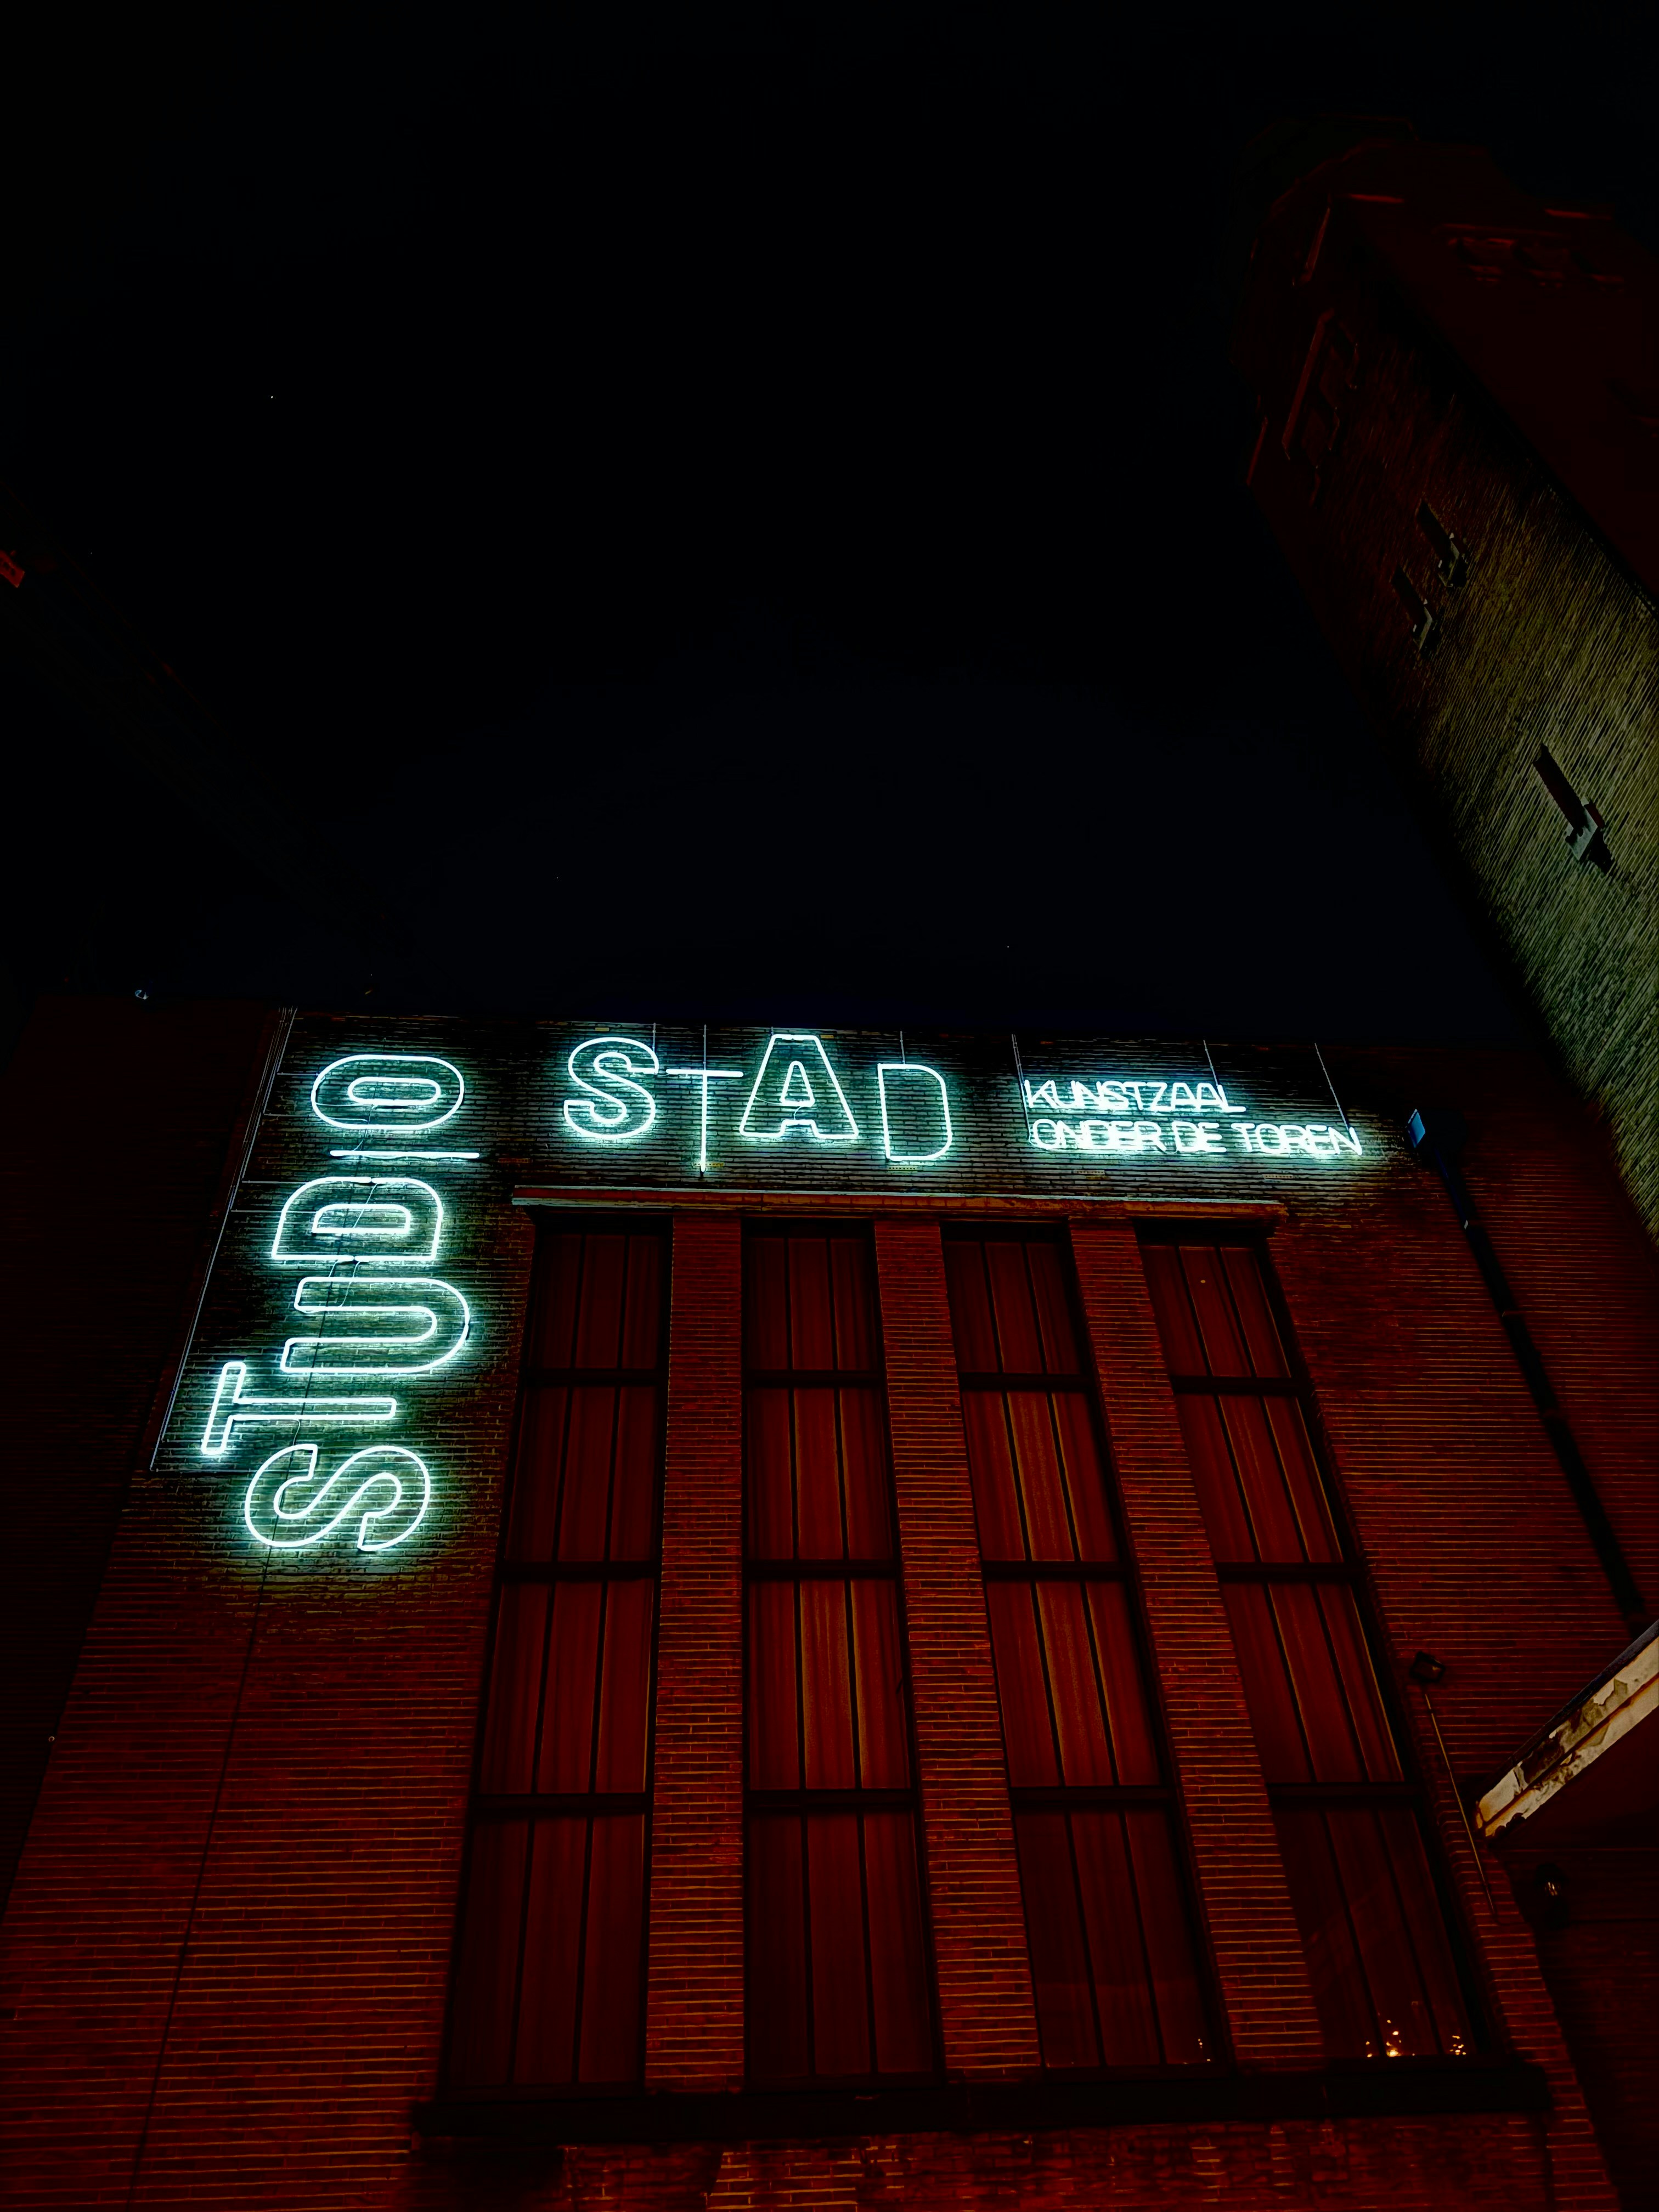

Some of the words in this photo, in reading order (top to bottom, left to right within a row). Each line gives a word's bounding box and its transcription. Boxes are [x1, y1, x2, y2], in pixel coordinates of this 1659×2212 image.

[563, 1034, 952, 1172] STAD
[1024, 1079, 1246, 1113] KUNSTZAAL
[1028, 1119, 1167, 1153] ONDER
[1172, 1121, 1227, 1153] DE
[1231, 1122, 1363, 1155] TOREN
[200, 1053, 481, 1551] STUDIO
